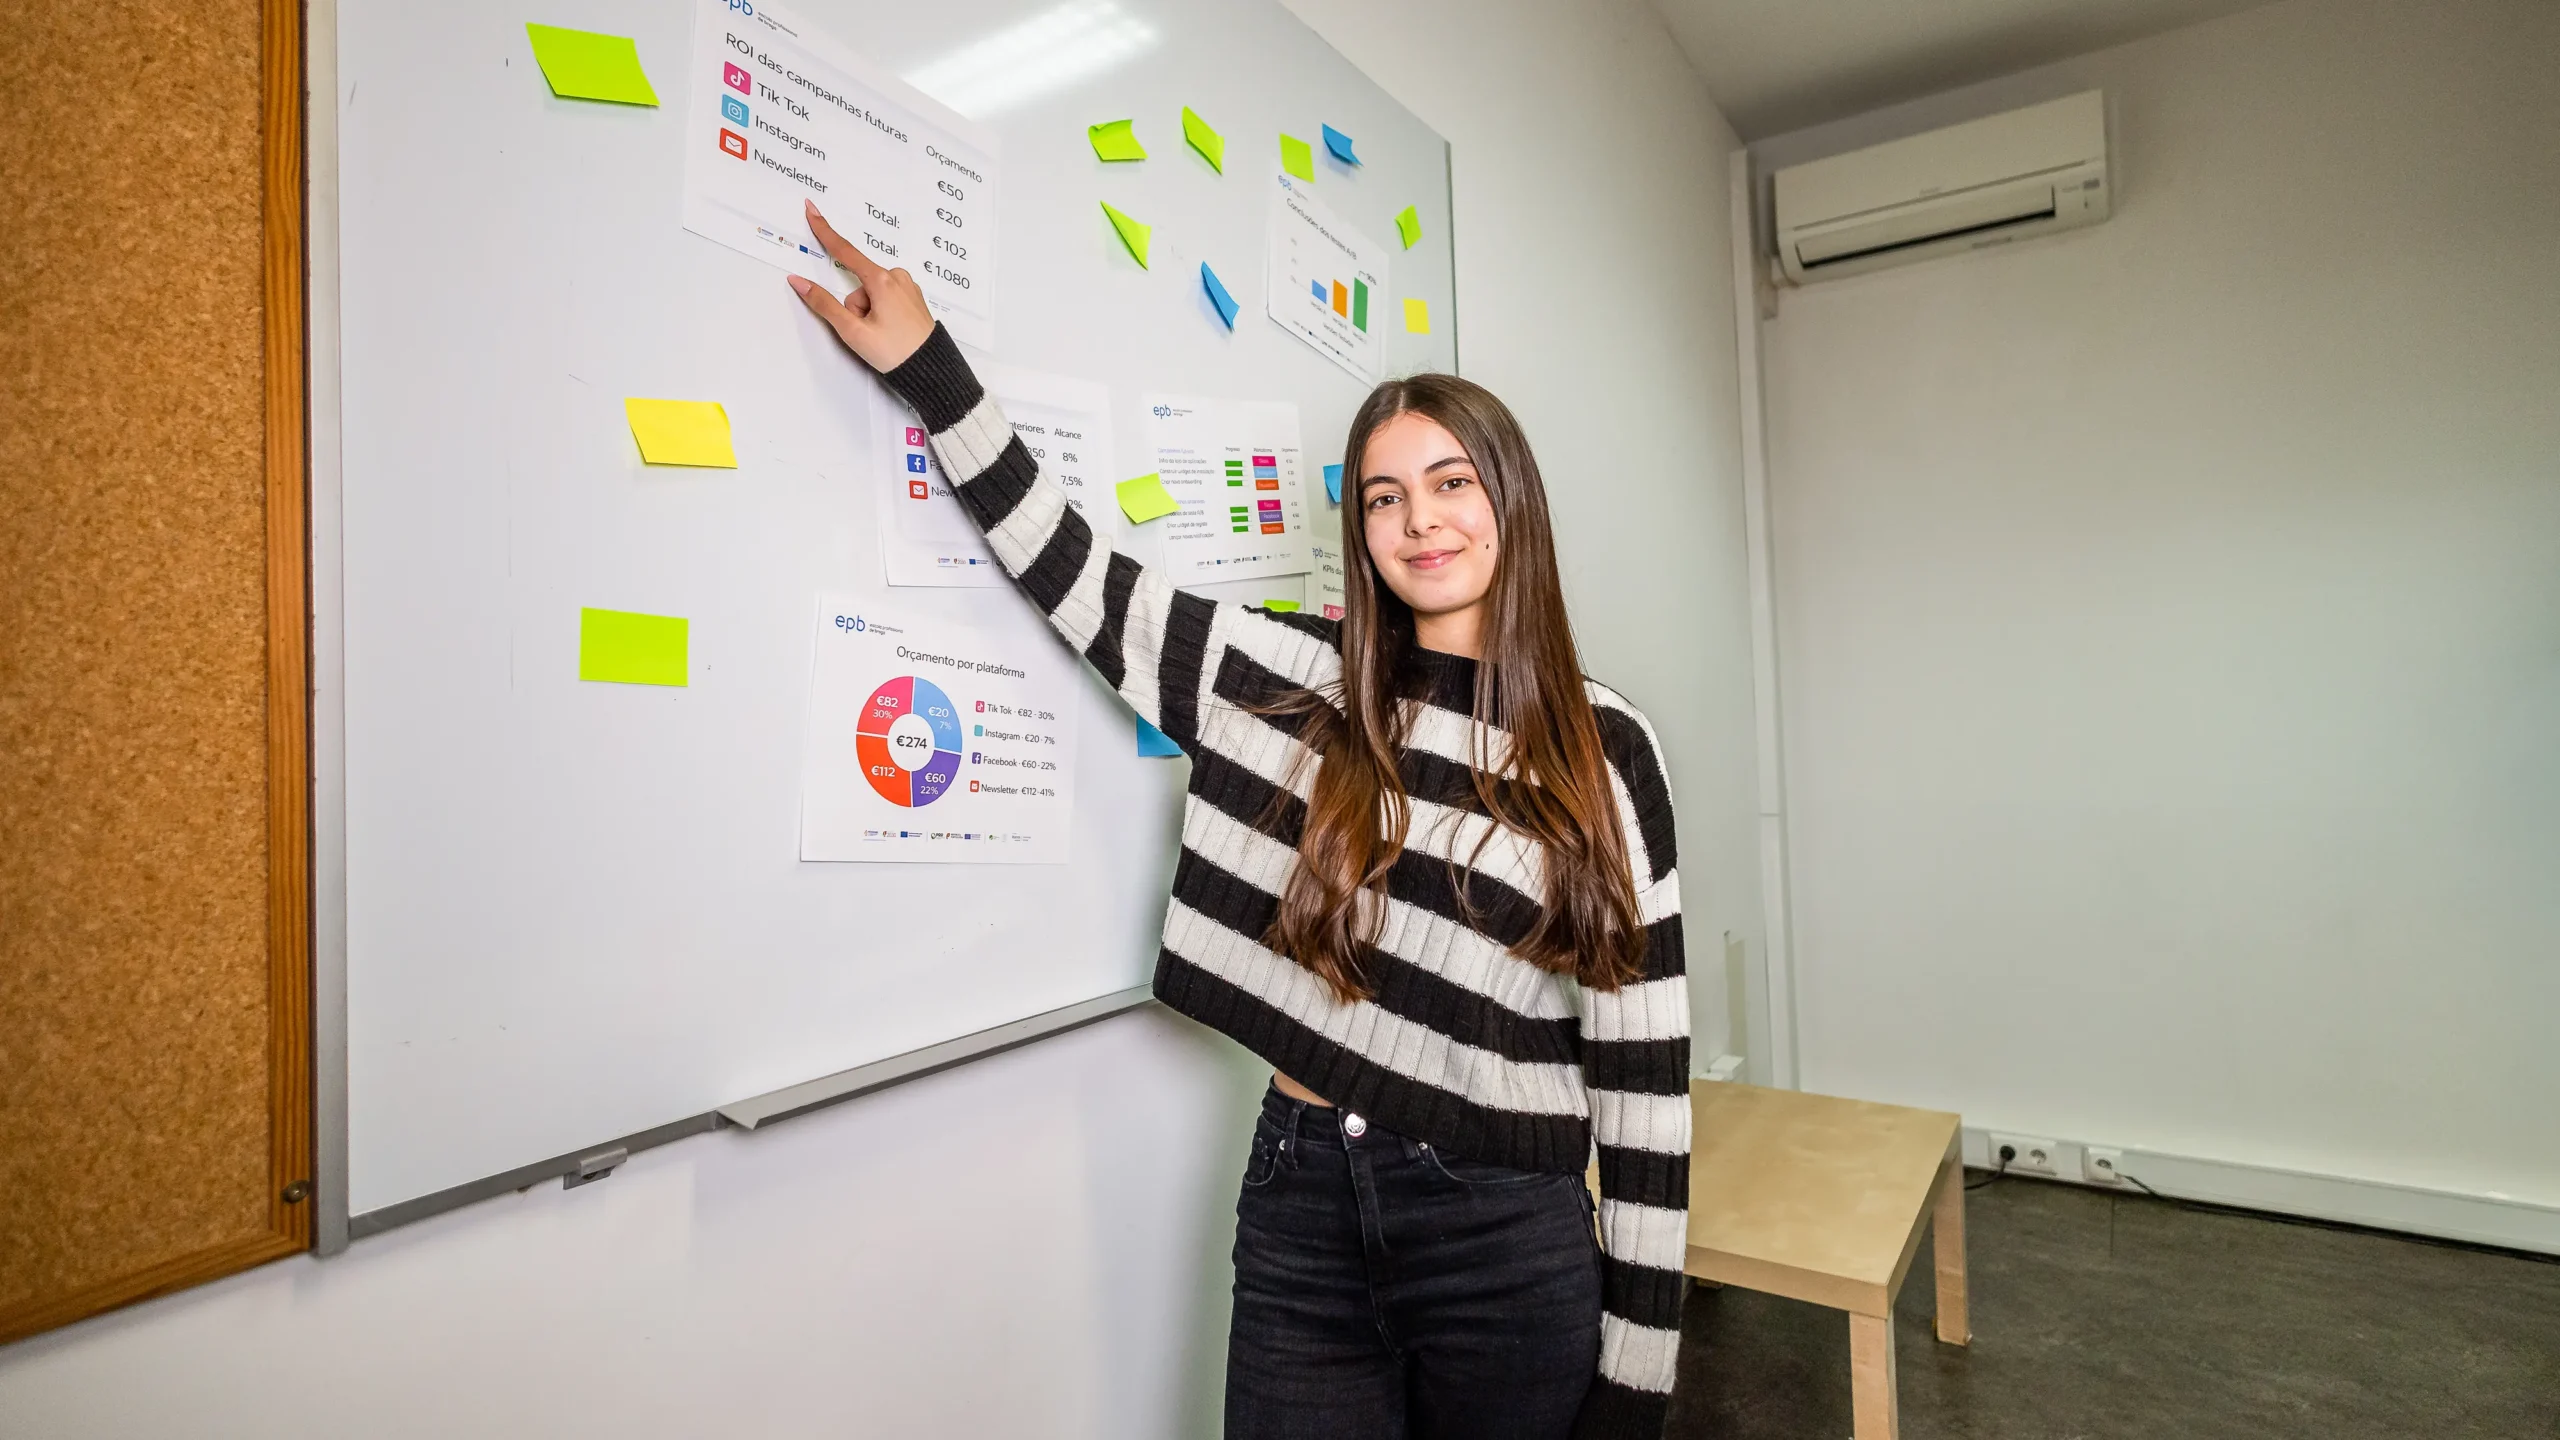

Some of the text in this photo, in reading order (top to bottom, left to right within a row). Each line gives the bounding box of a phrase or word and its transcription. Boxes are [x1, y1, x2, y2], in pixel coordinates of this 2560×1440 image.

[726, 32, 908, 144] ROI das campanhas futuras
[757, 81, 810, 122] Tik Tok
[755, 115, 826, 162] Instagram
[753, 149, 828, 194] Newsletter
[926, 145, 983, 184] Orçamento
[937, 180, 964, 202] €50
[865, 201, 963, 229] Total: €20
[932, 235, 968, 261] €102
[863, 231, 971, 291] Total: €1.080
[1153, 404, 1172, 420] epb
[1009, 421, 1082, 440] nteriores Alcance
[1062, 452, 1078, 463] 8%
[1061, 475, 1083, 487] 7,5%
[835, 614, 866, 634] epb
[896, 645, 1026, 679] Orçamento por plataforma
[876, 695, 899, 708] €82
[872, 708, 893, 719] 30%
[928, 706, 949, 718] €20
[987, 703, 1055, 721] Tik Tok €82 30%
[939, 721, 952, 731] 7%
[896, 735, 928, 749] €274
[985, 729, 1056, 745] Instagram €20 7%
[871, 765, 896, 777] €112
[983, 755, 1057, 771] Facebook €60 22%
[925, 772, 946, 784] €60
[920, 785, 939, 795] 22%
[981, 783, 1019, 795] Newsletter
